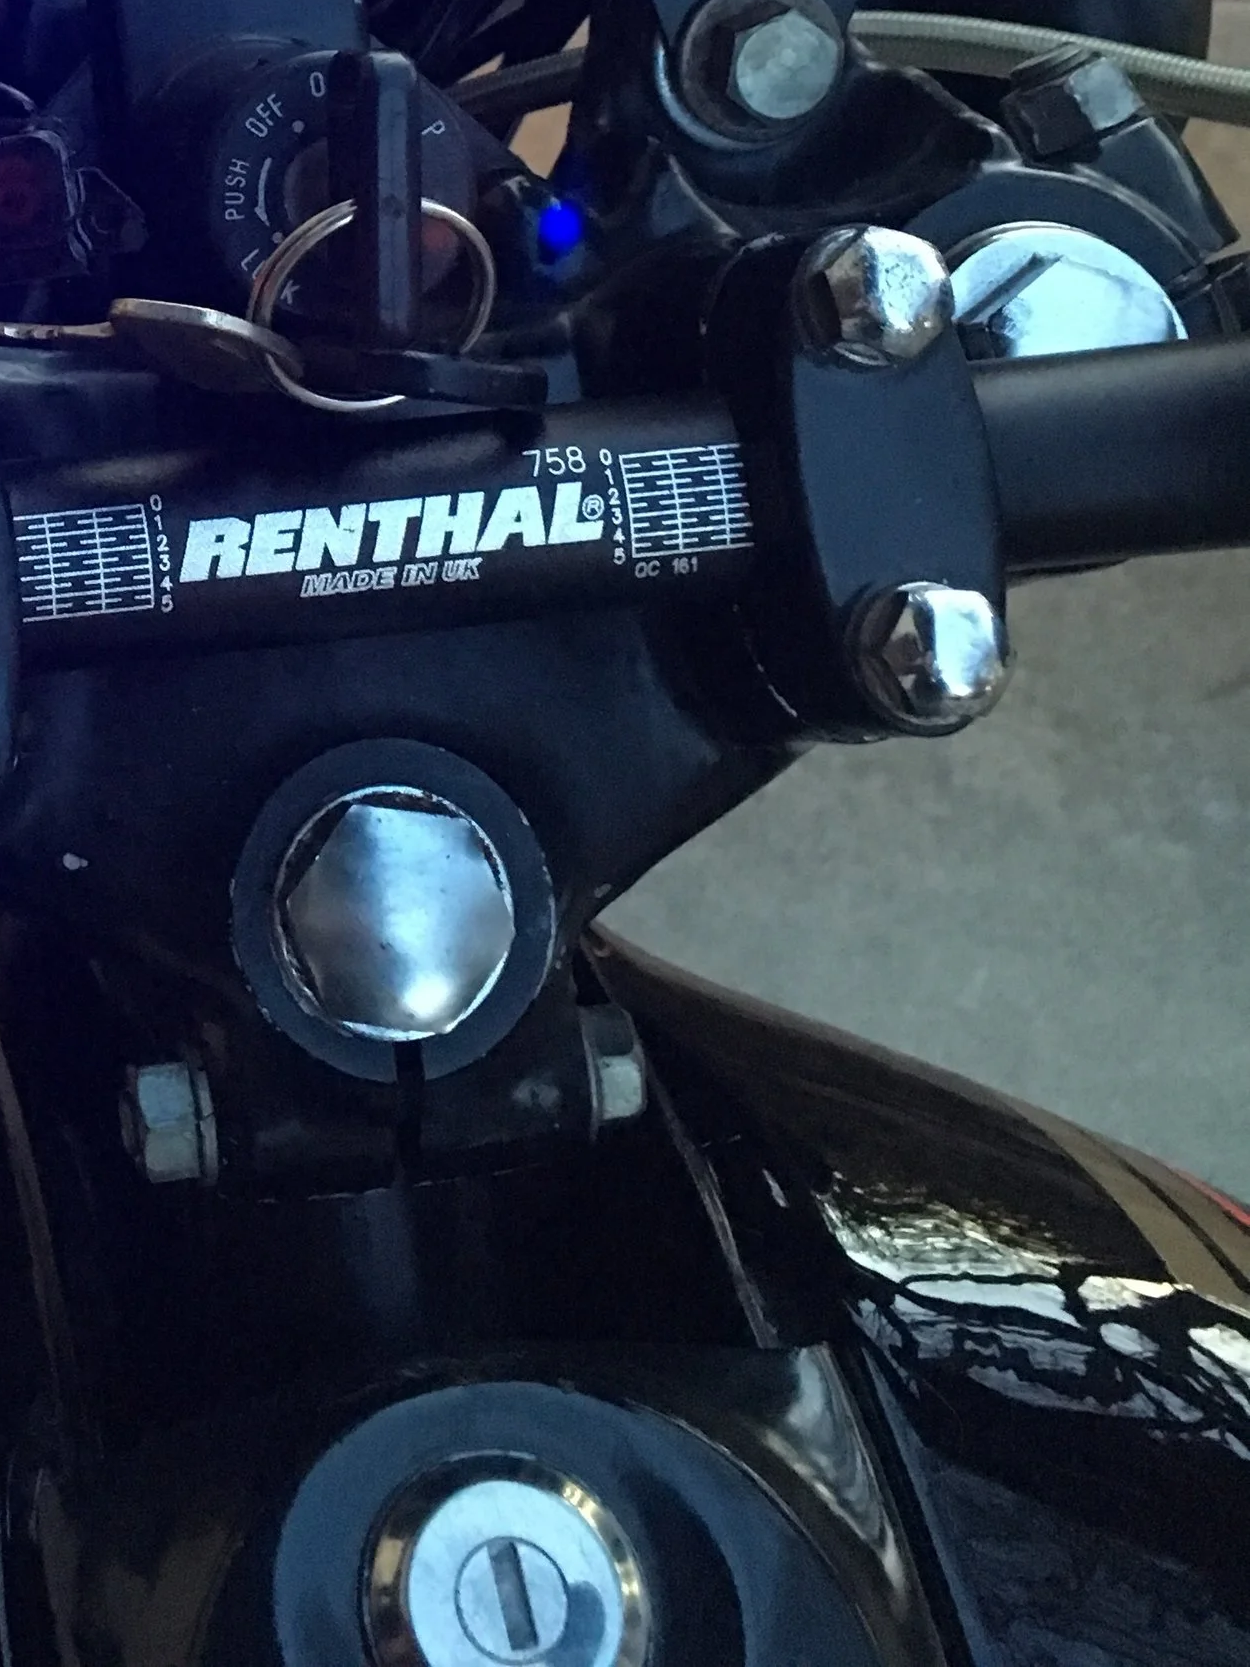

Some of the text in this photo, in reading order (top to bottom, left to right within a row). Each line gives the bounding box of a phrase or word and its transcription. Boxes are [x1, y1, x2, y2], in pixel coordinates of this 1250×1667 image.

[245, 93, 285, 138] OFF
[224, 159, 250, 221] PUSH
[522, 446, 586, 477] 758
[599, 449, 612, 465] 0
[604, 468, 614, 485] 1
[150, 494, 162, 512] 0
[608, 488, 620, 505] 2
[153, 515, 162, 530] 1
[611, 508, 623, 525] 3
[156, 534, 170, 552] 2
[613, 527, 625, 546] 4
[159, 554, 171, 572] 3
[613, 547, 626, 565] 5
[160, 576, 174, 591] 4
[299, 557, 485, 598] MADE IN UK
[161, 594, 174, 613] 5
